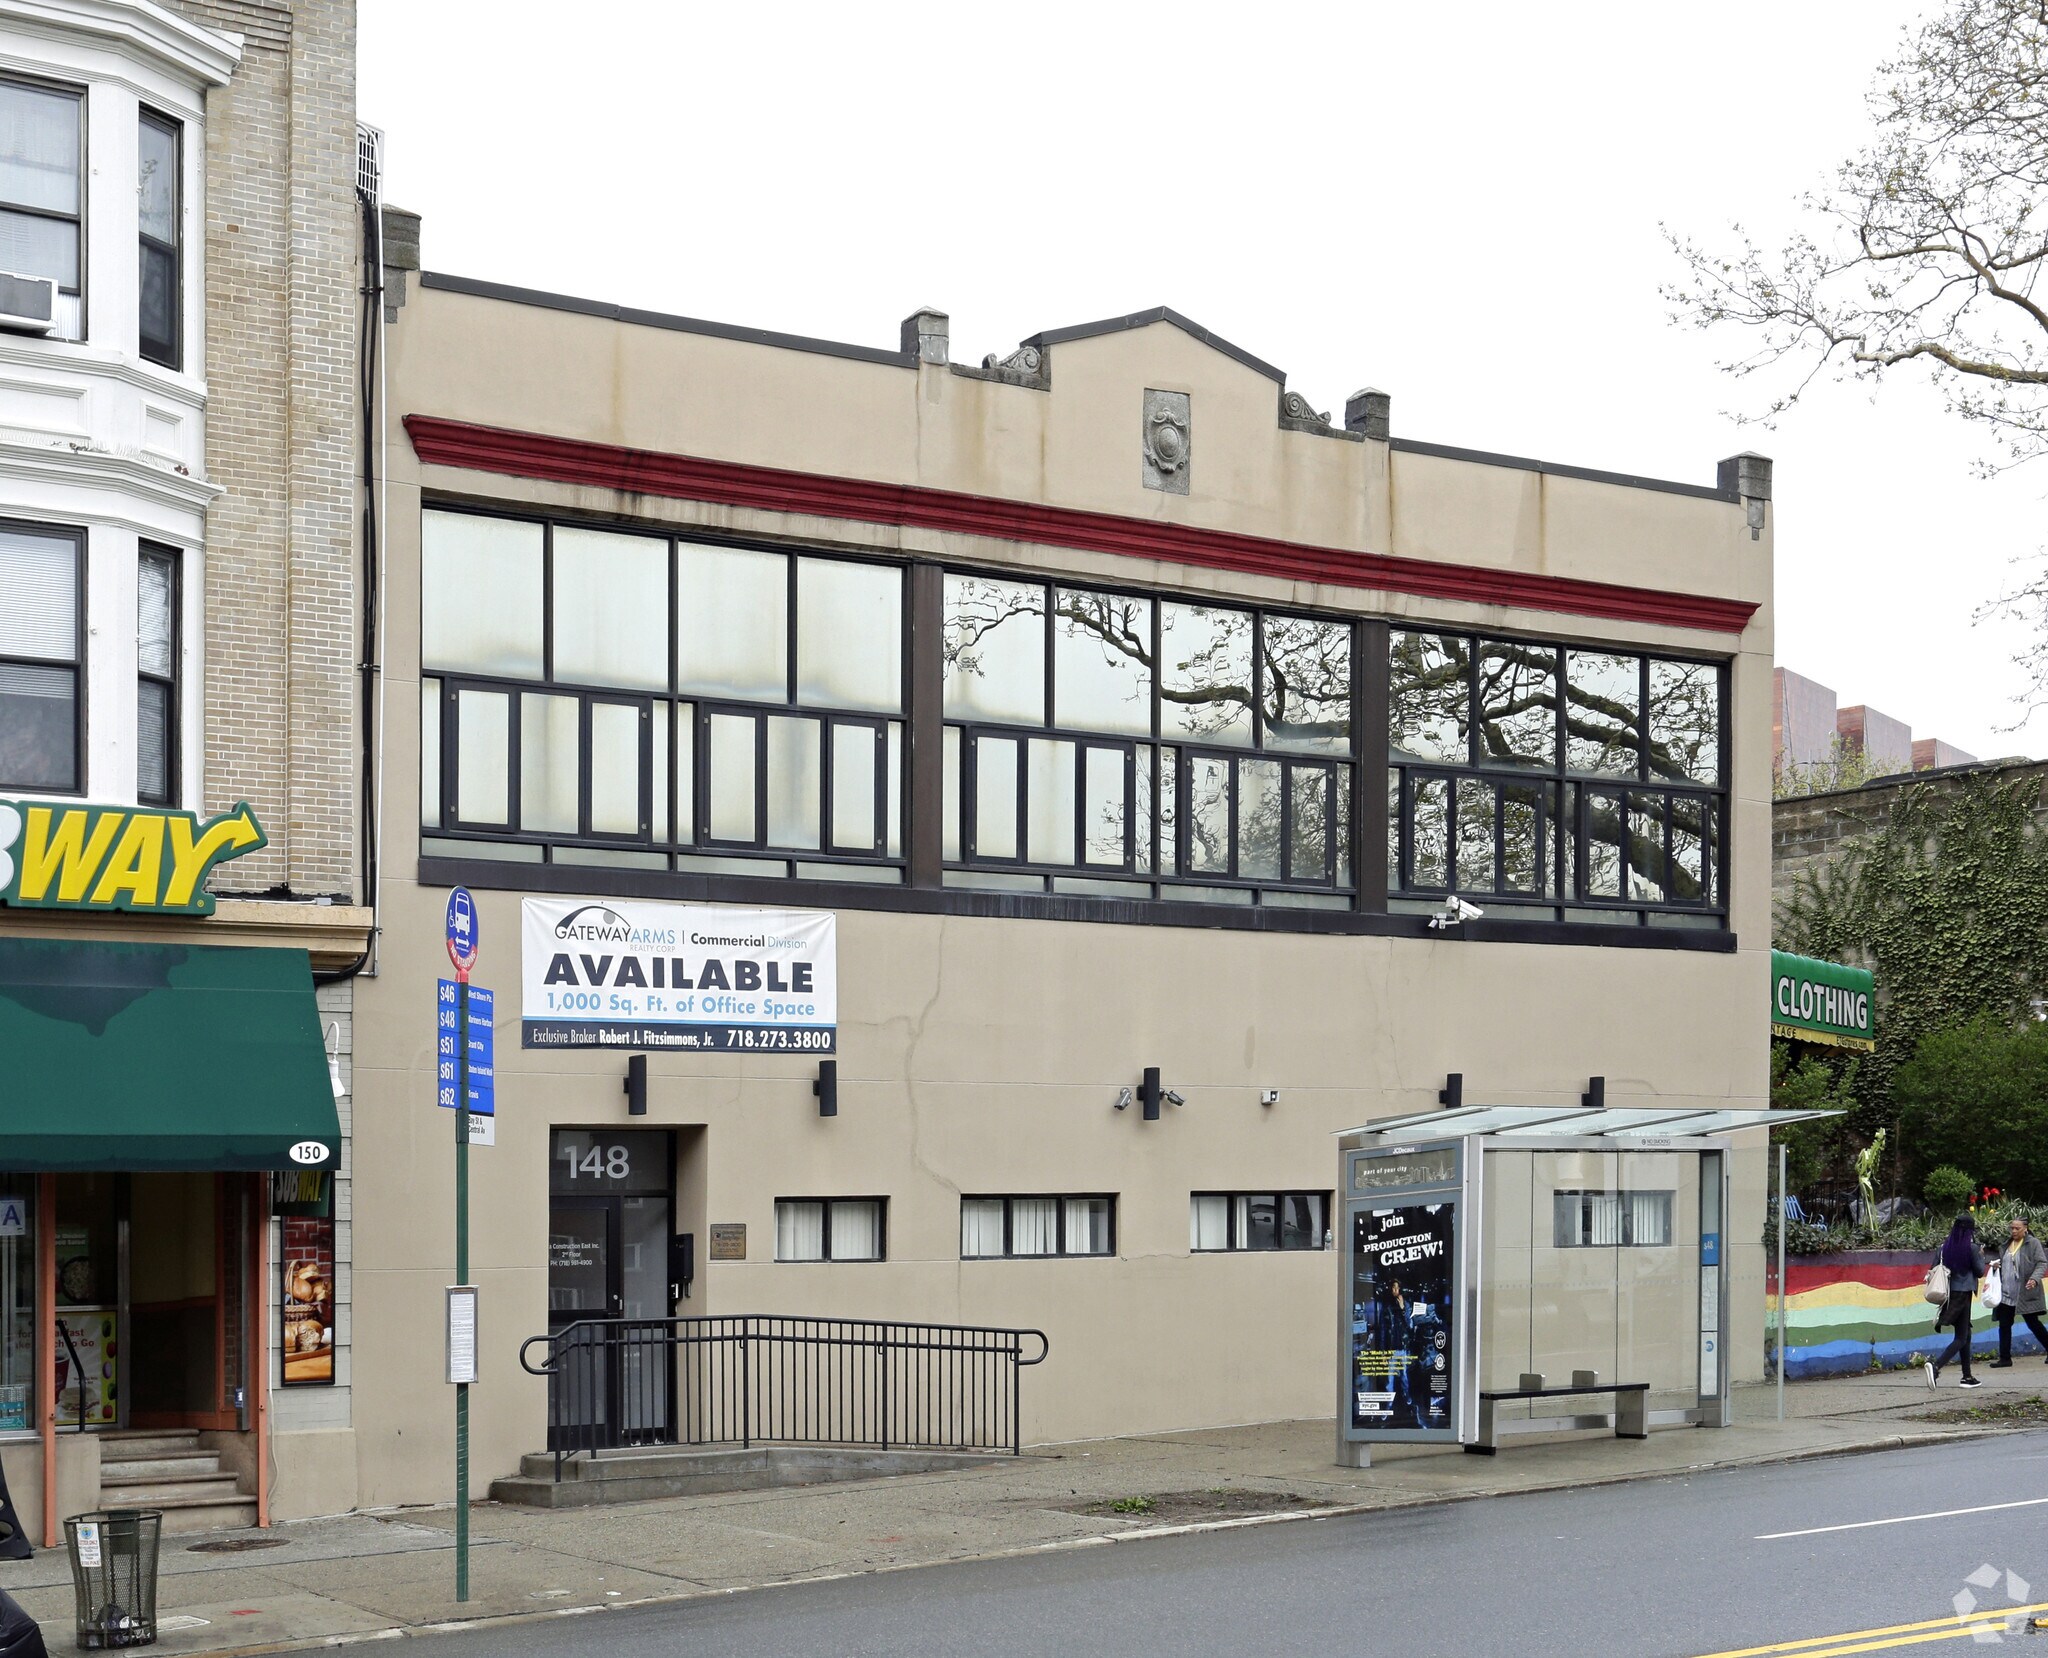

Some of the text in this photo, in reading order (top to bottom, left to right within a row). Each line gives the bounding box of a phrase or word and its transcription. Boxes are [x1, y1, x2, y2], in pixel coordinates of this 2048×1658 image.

[630, 944, 676, 953] REALTY CORP
[691, 933, 765, 947] Commercial
[768, 936, 807, 949] Division
[543, 953, 813, 993] AVAILABLE
[547, 992, 815, 1019] 1,000 Sq. Ft. of Office Space
[1777, 976, 1868, 1030] CLOTHING
[533, 1027, 831, 1048] Exclusive Broker Robert J. Fitzsimmons, Jr. 718.273.3800
[298, 1146, 321, 1160] 150
[564, 1145, 630, 1179] 148
[1363, 1168, 1375, 1176] part
[1383, 1166, 1396, 1174] your
[2, 1204, 21, 1226] A
[1380, 1215, 1404, 1232] join
[1363, 1232, 1432, 1253] PRODUCTION
[1380, 1240, 1443, 1266] CREW!
[81, 1339, 95, 1348] Go
